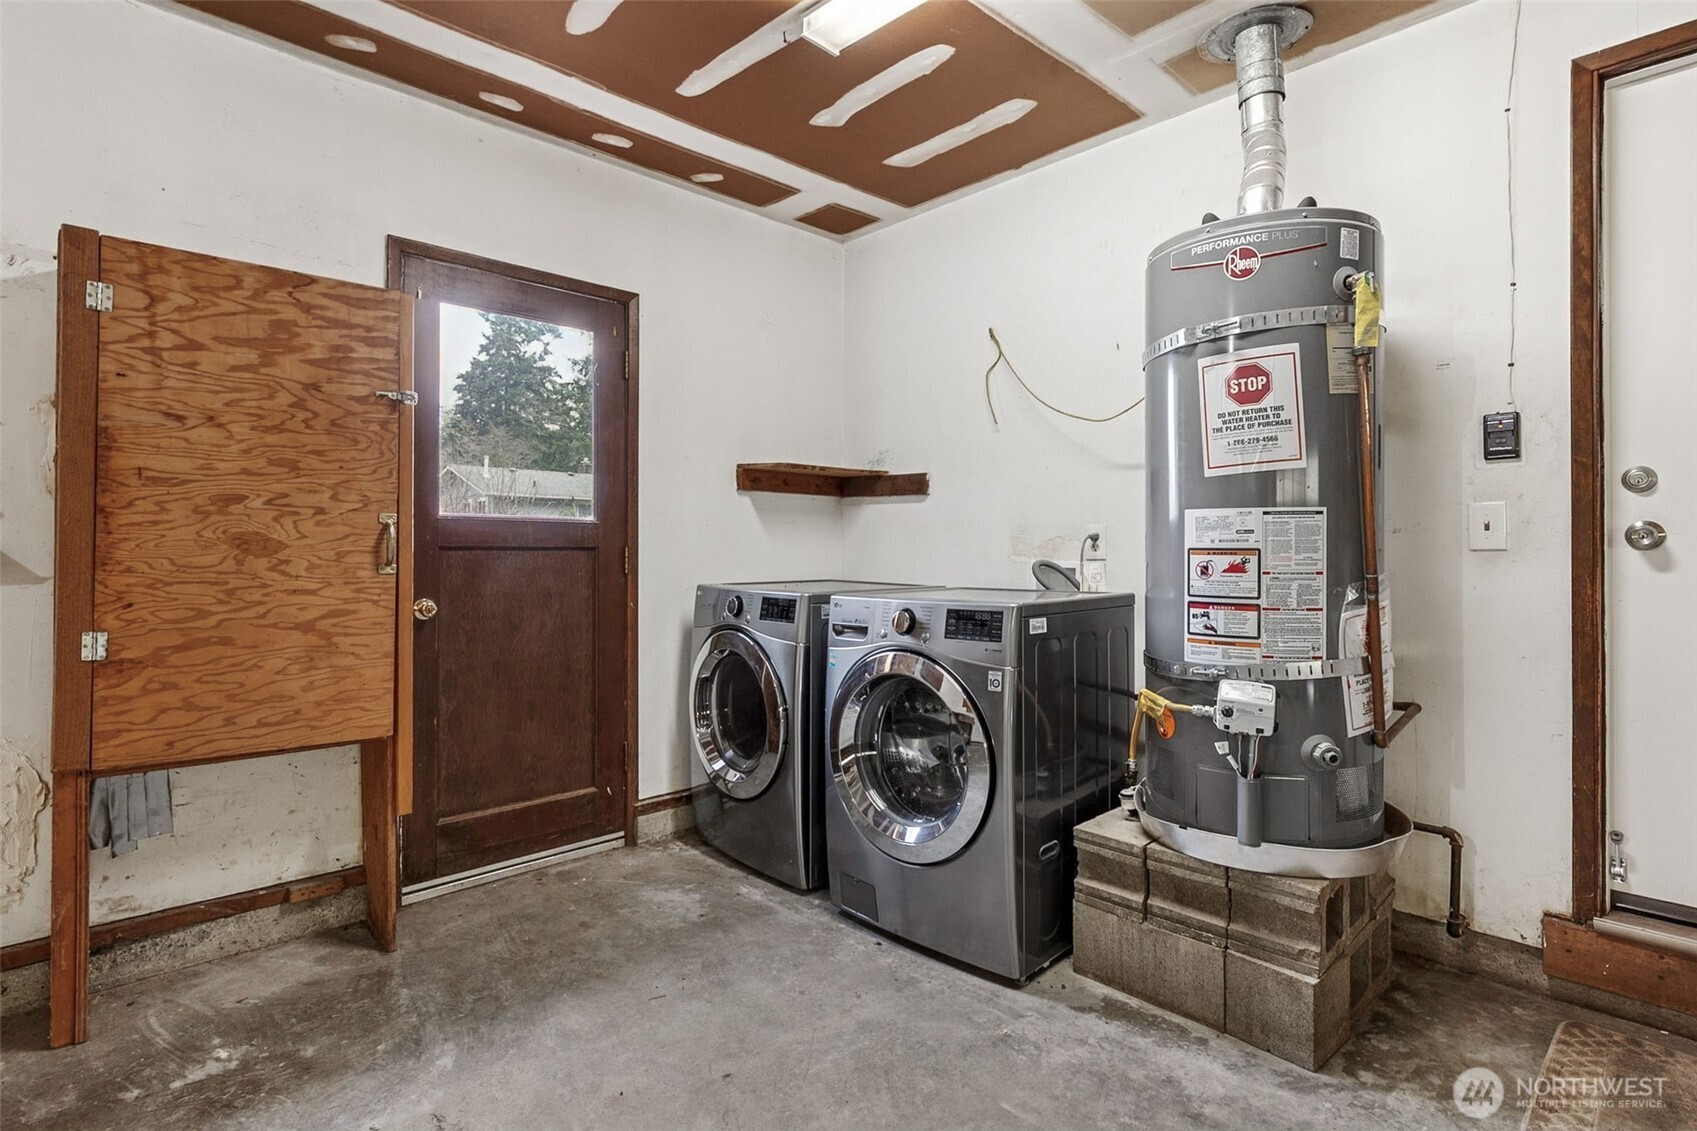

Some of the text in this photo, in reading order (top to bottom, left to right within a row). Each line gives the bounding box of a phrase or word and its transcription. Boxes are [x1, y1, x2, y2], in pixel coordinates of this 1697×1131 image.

[1191, 230, 1299, 256] PERFORMANCE PLUS
[1228, 247, 1258, 275] Rheem
[1229, 376, 1267, 394] STOP
[1227, 410, 1240, 418] NOT
[1241, 406, 1268, 416] RETURN
[1269, 404, 1285, 412] THIS
[1221, 417, 1244, 426] WATER
[1245, 413, 1271, 422] HEATER
[1225, 423, 1246, 432] PLACE
[1257, 418, 1292, 428] PURCHASE
